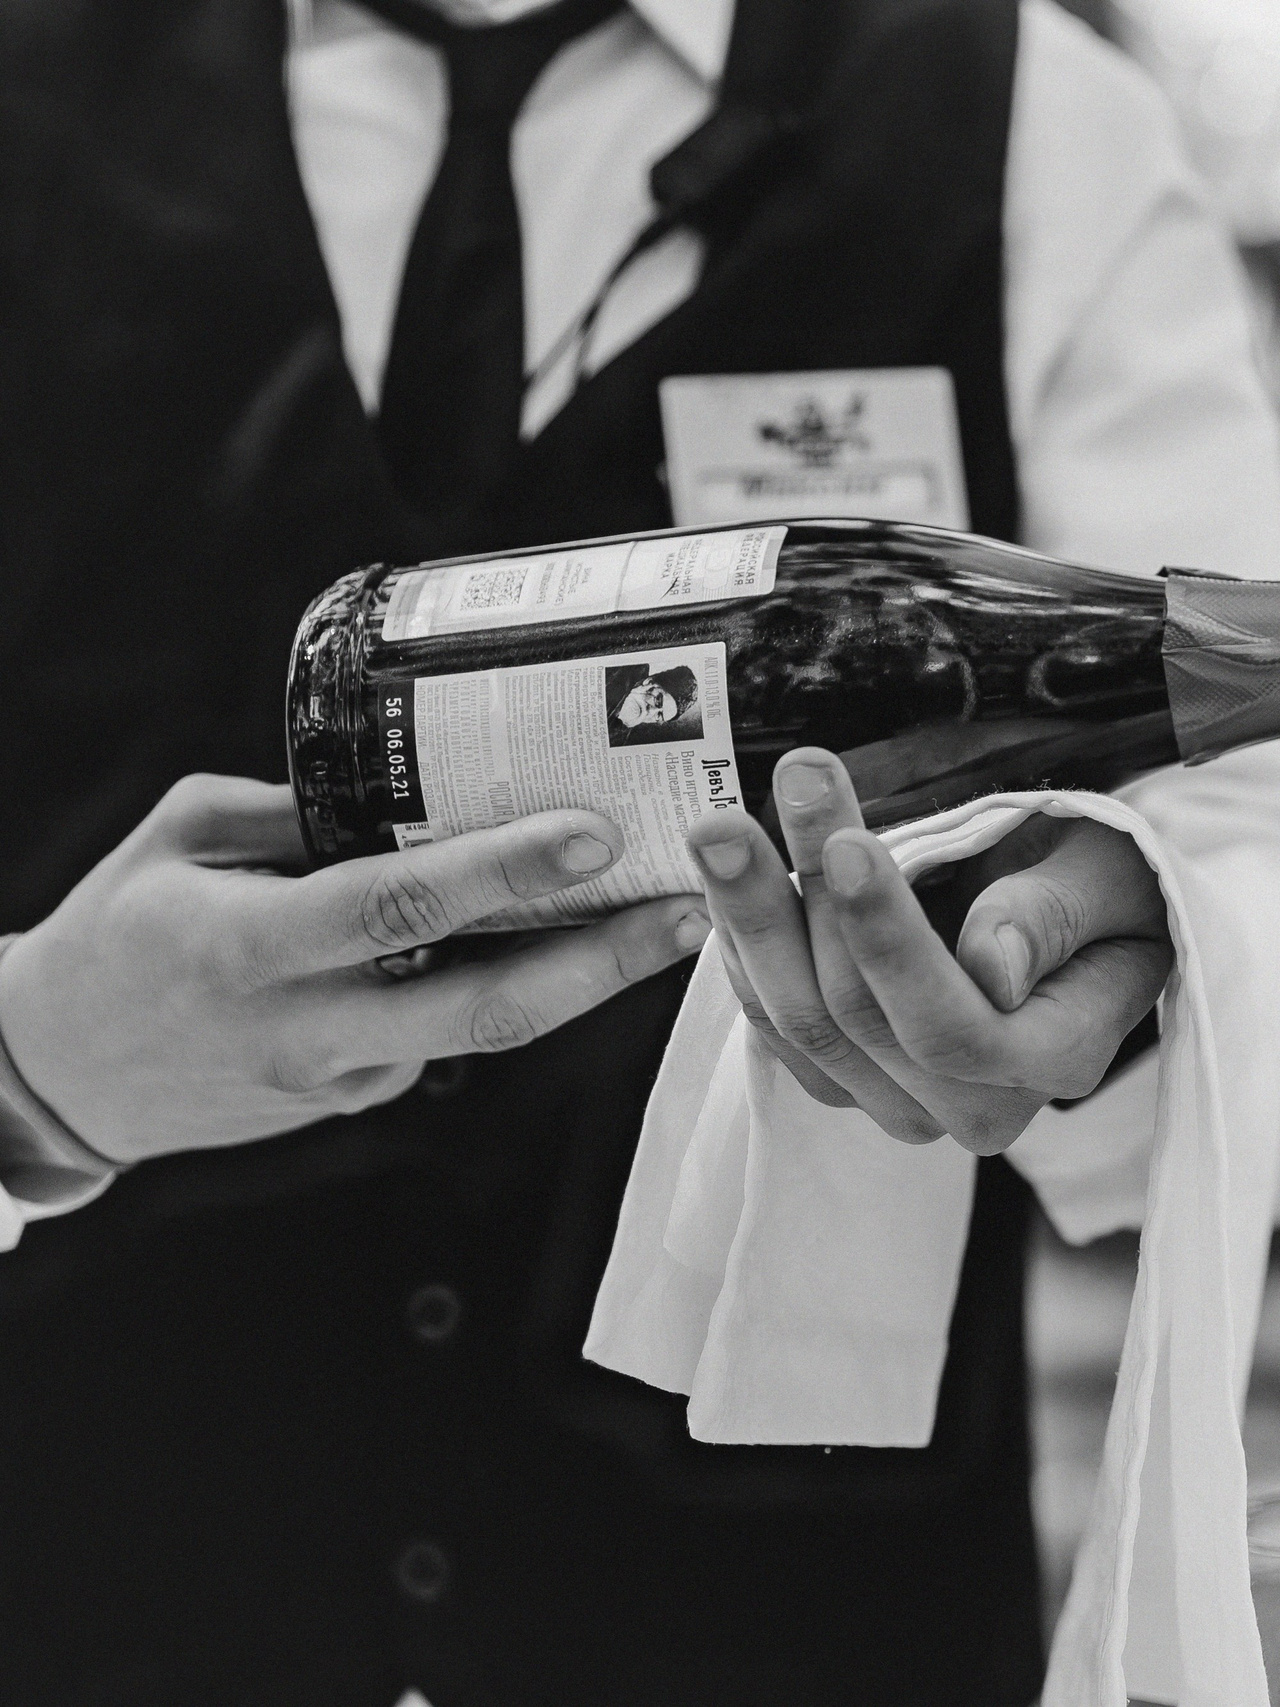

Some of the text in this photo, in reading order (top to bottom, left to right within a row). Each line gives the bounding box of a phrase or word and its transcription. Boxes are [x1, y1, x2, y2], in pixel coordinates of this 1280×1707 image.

[416, 685, 426, 714] НОМЕР
[567, 669, 575, 703] Идеально
[582, 667, 591, 713] температура
[590, 692, 598, 709] Вкус
[417, 715, 427, 750] ПАРТИИ:
[569, 710, 577, 747] яблочным
[573, 668, 583, 735] Гастрономические
[578, 737, 588, 776] сочетания:
[584, 714, 596, 764] употребления
[592, 711, 600, 737] мягкий
[386, 698, 410, 799] 56 06.05.21
[571, 748, 580, 778] пирогом
[681, 750, 695, 777] Вино
[419, 762, 431, 782] ДАТА
[595, 748, 608, 795] гармоничный
[611, 757, 622, 798] консервант
[624, 756, 634, 782] Состав:
[643, 753, 655, 795] Голицына,
[651, 753, 662, 787] Названо
[665, 751, 682, 802] «Наследие
[701, 759, 731, 795] Левъ
[487, 780, 515, 820] РОССИЯ,
